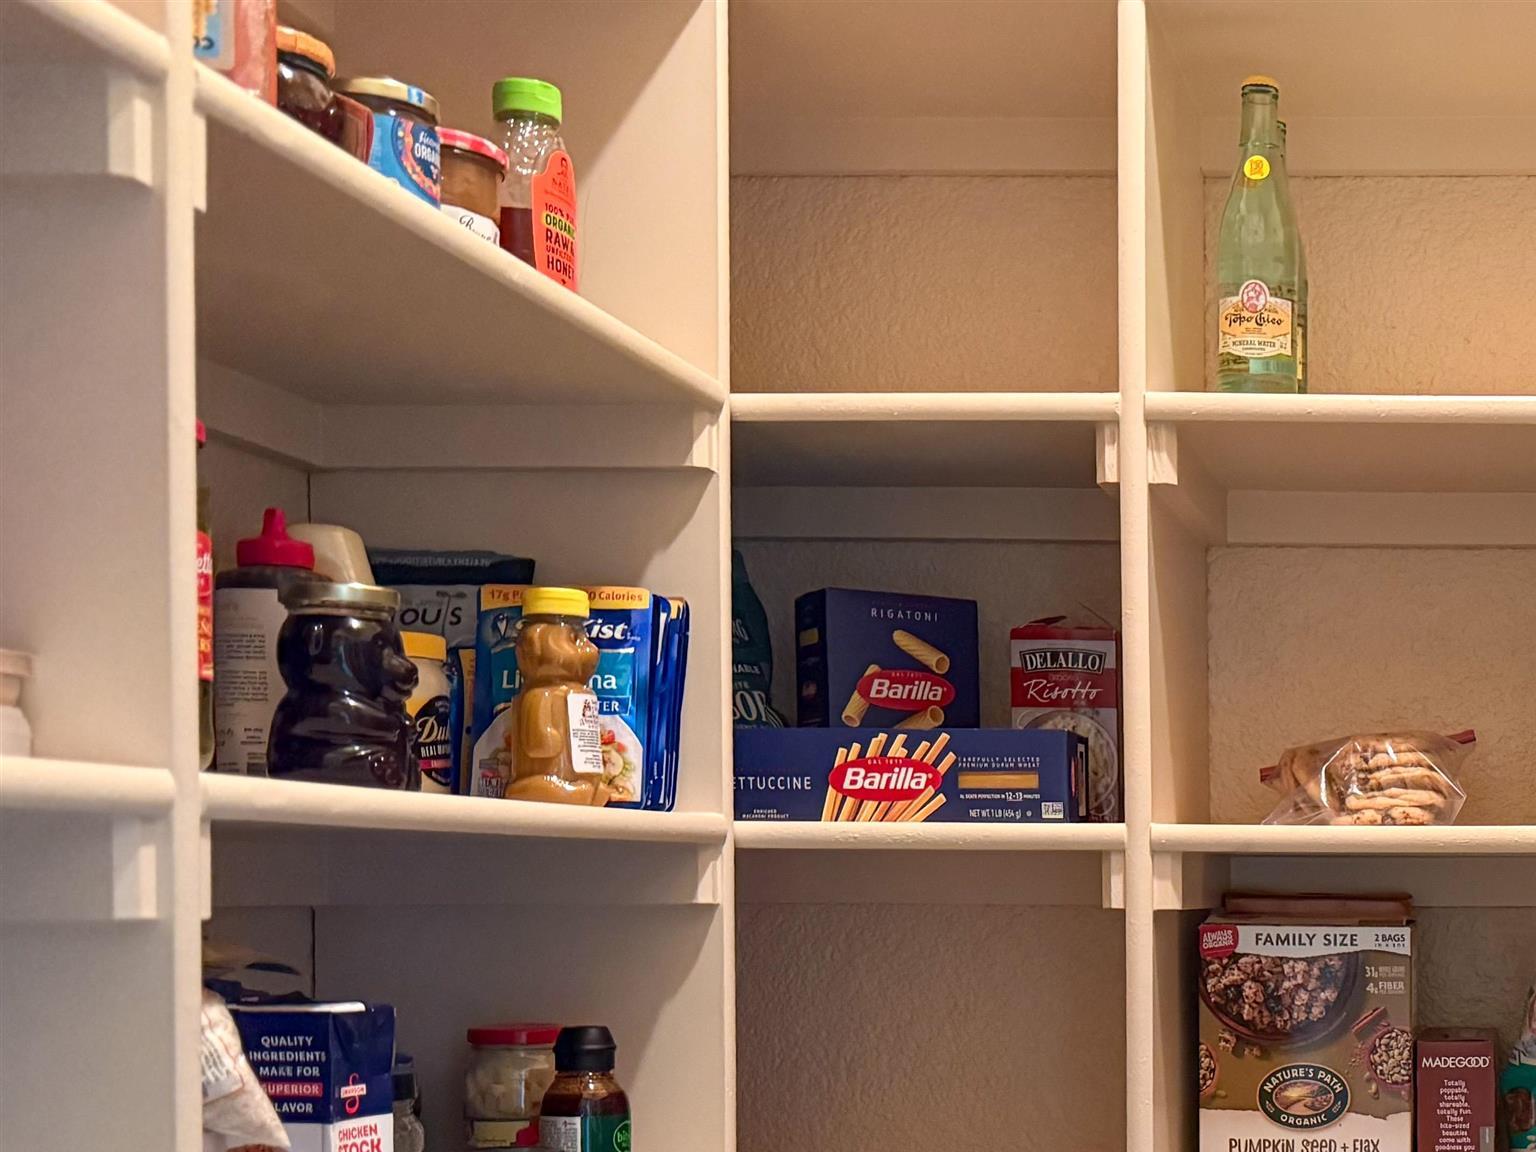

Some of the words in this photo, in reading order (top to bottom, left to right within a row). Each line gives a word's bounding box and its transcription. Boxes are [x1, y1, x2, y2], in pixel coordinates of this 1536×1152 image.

[1225, 312, 1254, 327] Topo
[1255, 312, 1284, 326] Chico
[599, 590, 643, 601] Calories
[871, 608, 938, 622] RIGATONI
[1025, 652, 1100, 670] DELALLO
[869, 679, 944, 701] Barilla
[1023, 679, 1104, 702] Risotto
[842, 767, 933, 790] Barilla
[969, 809, 980, 817] NET
[1255, 933, 1316, 946] FAMILY
[1323, 934, 1358, 946] SIZE
[1374, 934, 1380, 942] 2
[1382, 934, 1406, 942] BAGS
[261, 1036, 313, 1048] QUALITY
[249, 1050, 326, 1063] INGREDIENTS
[1422, 1056, 1490, 1068] MADEGOOD
[259, 1066, 293, 1077] MAKE
[296, 1066, 321, 1077] FOR
[1263, 1068, 1314, 1093] NATURE'S
[1317, 1070, 1344, 1093] PATH
[1444, 1080, 1465, 1088] Totally
[1444, 1094, 1465, 1102] totally
[1437, 1108, 1458, 1116] totally
[1280, 1114, 1328, 1126] ORGANIC
[338, 1123, 378, 1142] CHICKEN
